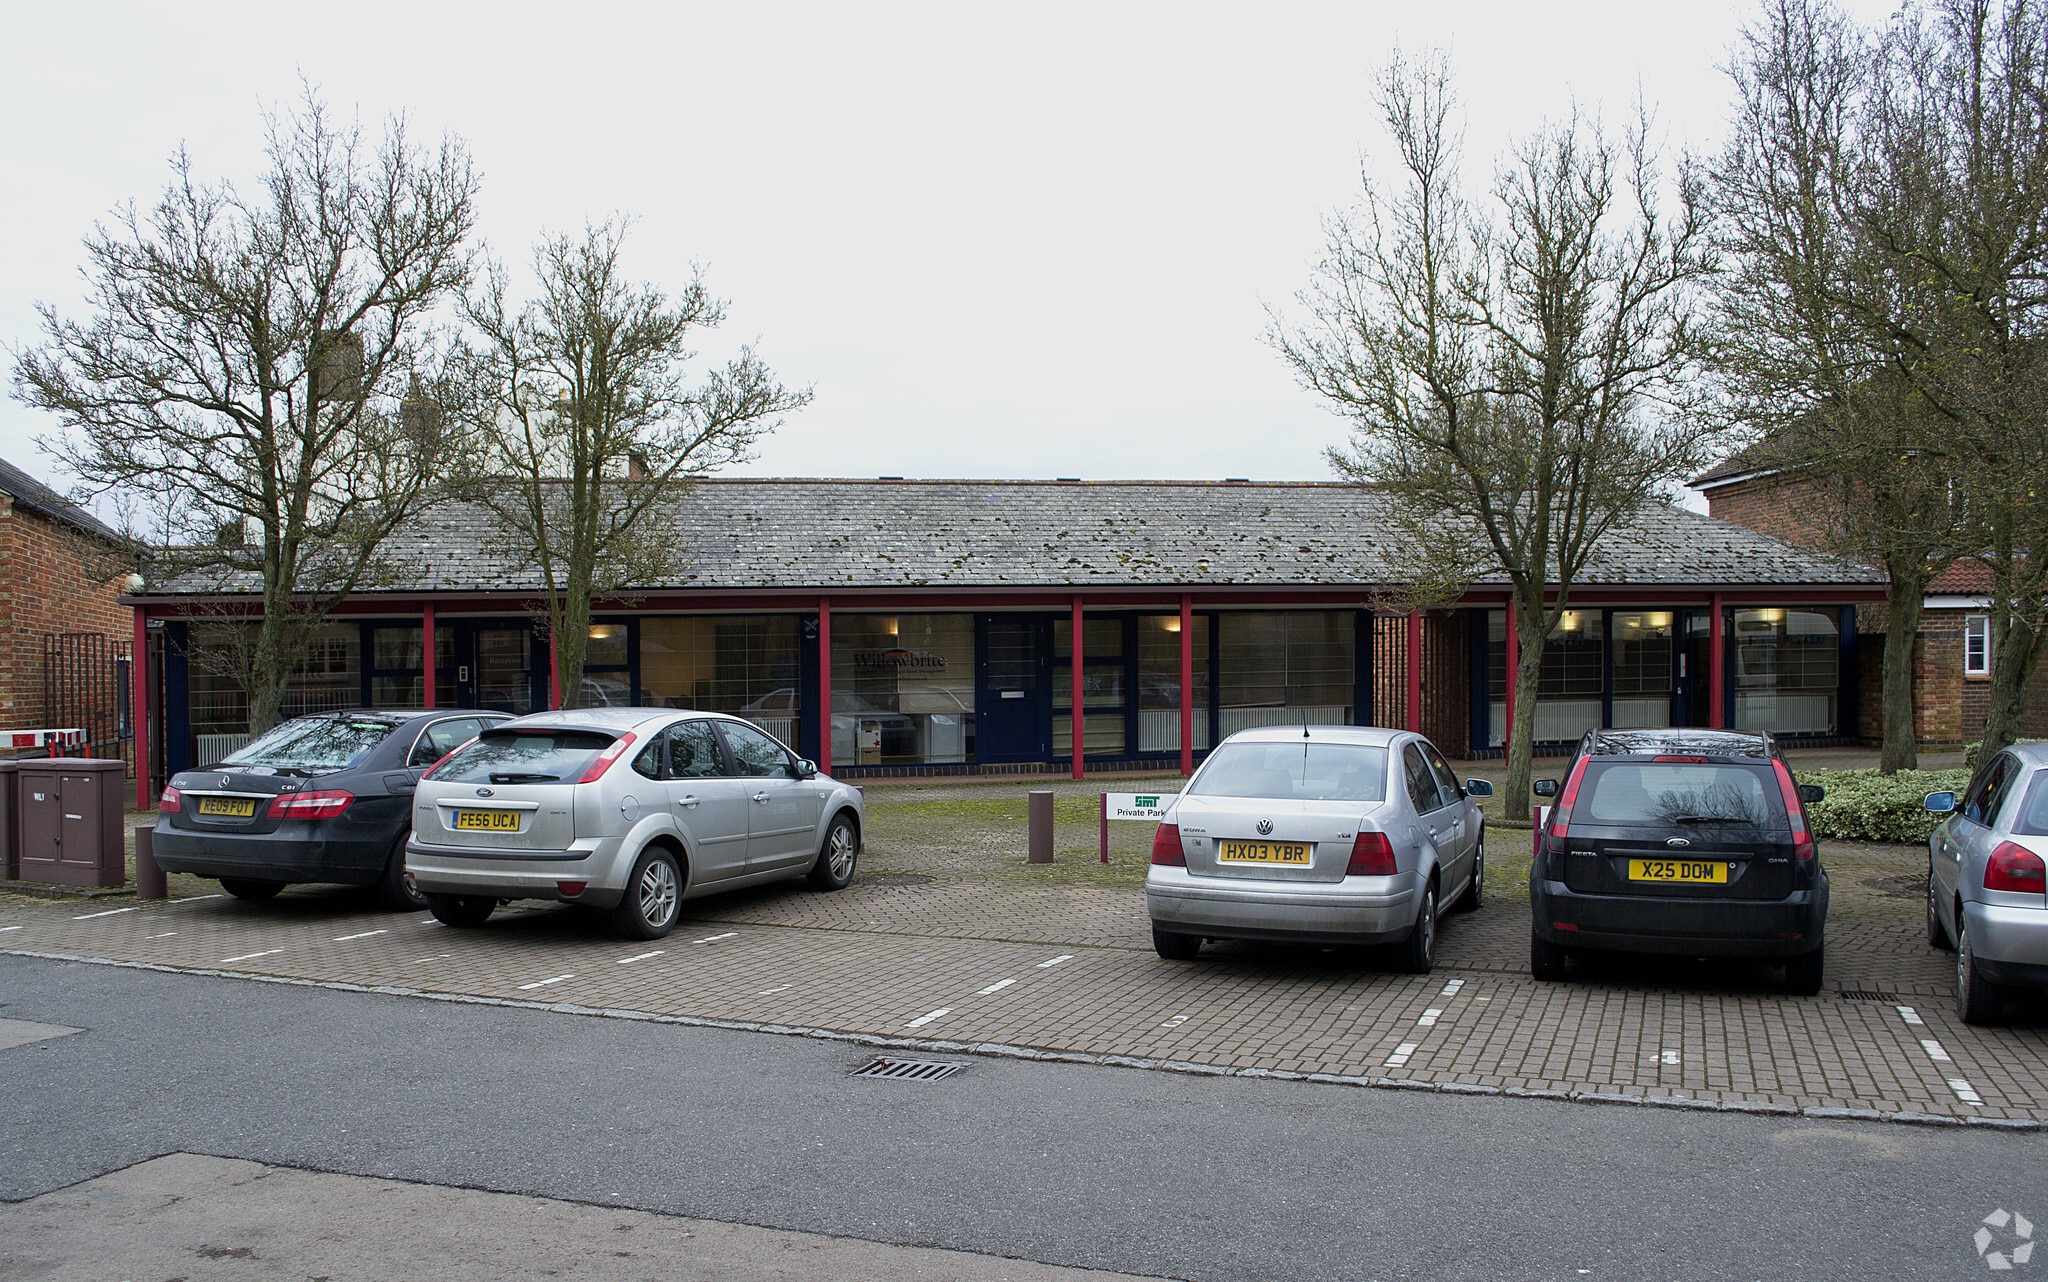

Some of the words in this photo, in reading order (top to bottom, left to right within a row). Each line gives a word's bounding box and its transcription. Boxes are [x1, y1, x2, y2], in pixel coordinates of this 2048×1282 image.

[853, 652, 947, 668] Willowbrite
[203, 797, 229, 813] RE09
[231, 799, 250, 814] FOT
[1117, 809, 1145, 817] Private
[460, 813, 490, 827] FE56
[493, 814, 516, 828] UCA
[1226, 844, 1268, 859] HX03
[1273, 846, 1304, 861] YBR
[1642, 862, 1676, 878] X25
[1680, 863, 1714, 879] DOM
